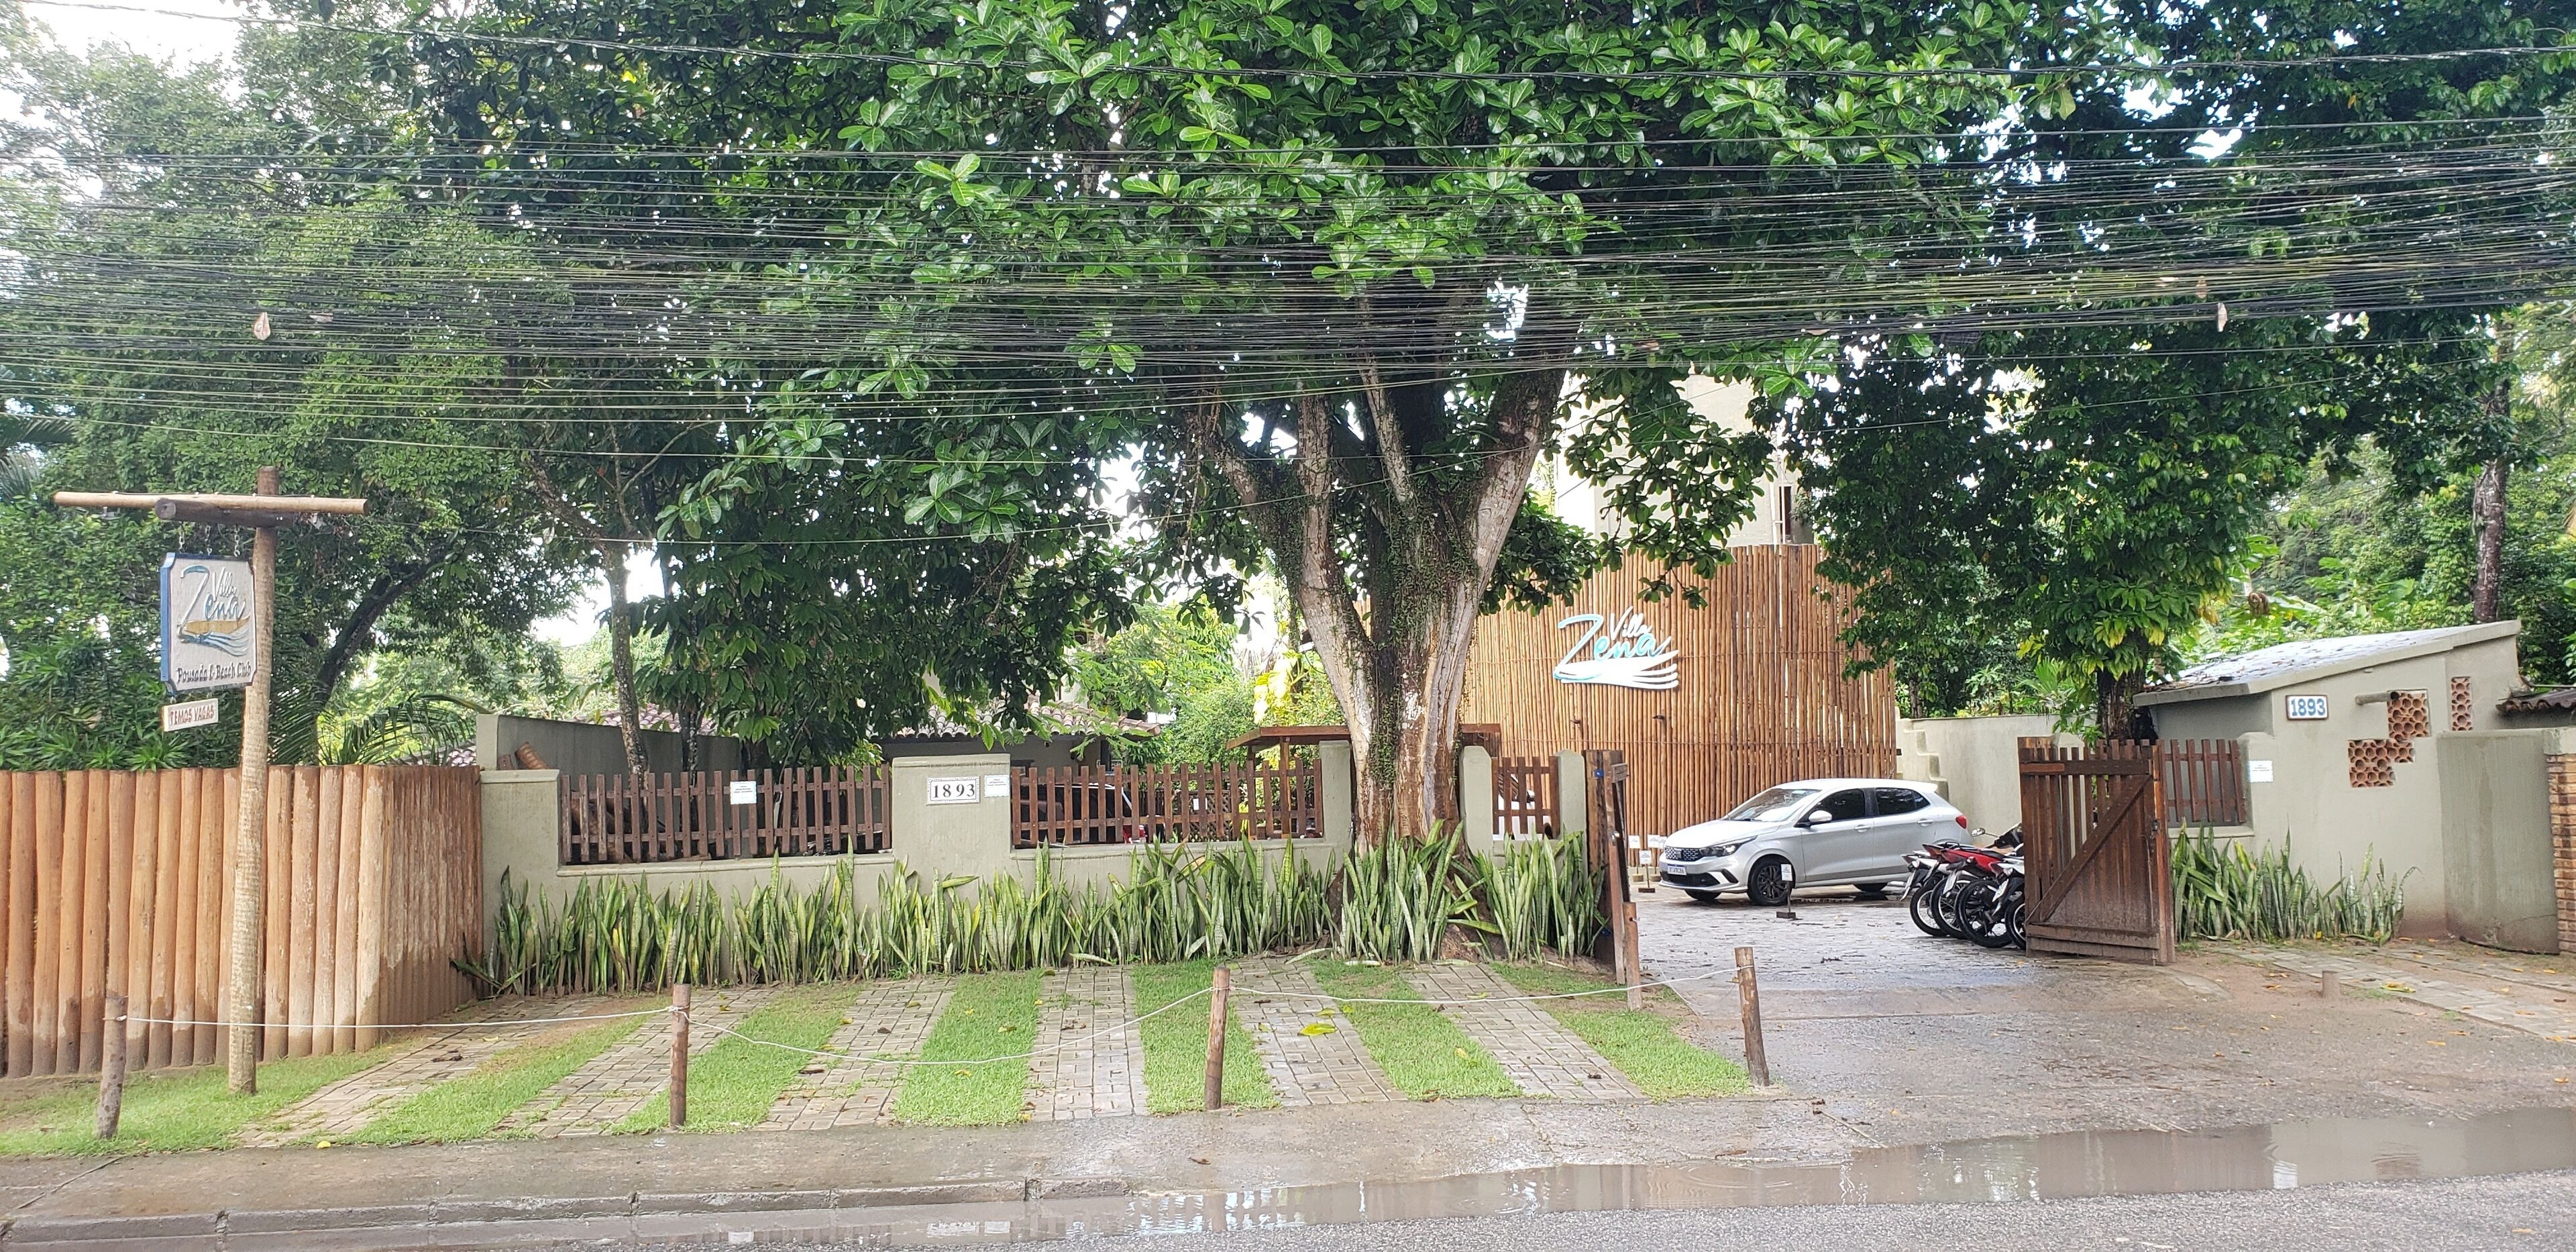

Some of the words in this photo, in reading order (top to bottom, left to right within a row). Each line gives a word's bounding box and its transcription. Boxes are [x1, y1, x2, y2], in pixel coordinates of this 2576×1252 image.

[213, 567, 237, 601] Villa
[178, 565, 246, 637] Zena
[1610, 606, 1653, 639] Villa
[1554, 613, 1672, 676] Zena
[176, 666, 207, 684] Pousada
[215, 663, 235, 680] Beach
[237, 661, 252, 678] Club
[169, 708, 192, 726] TEMOS
[193, 705, 215, 722] VAGAS
[2291, 698, 2326, 716] 1893
[933, 784, 975, 798] 1893
